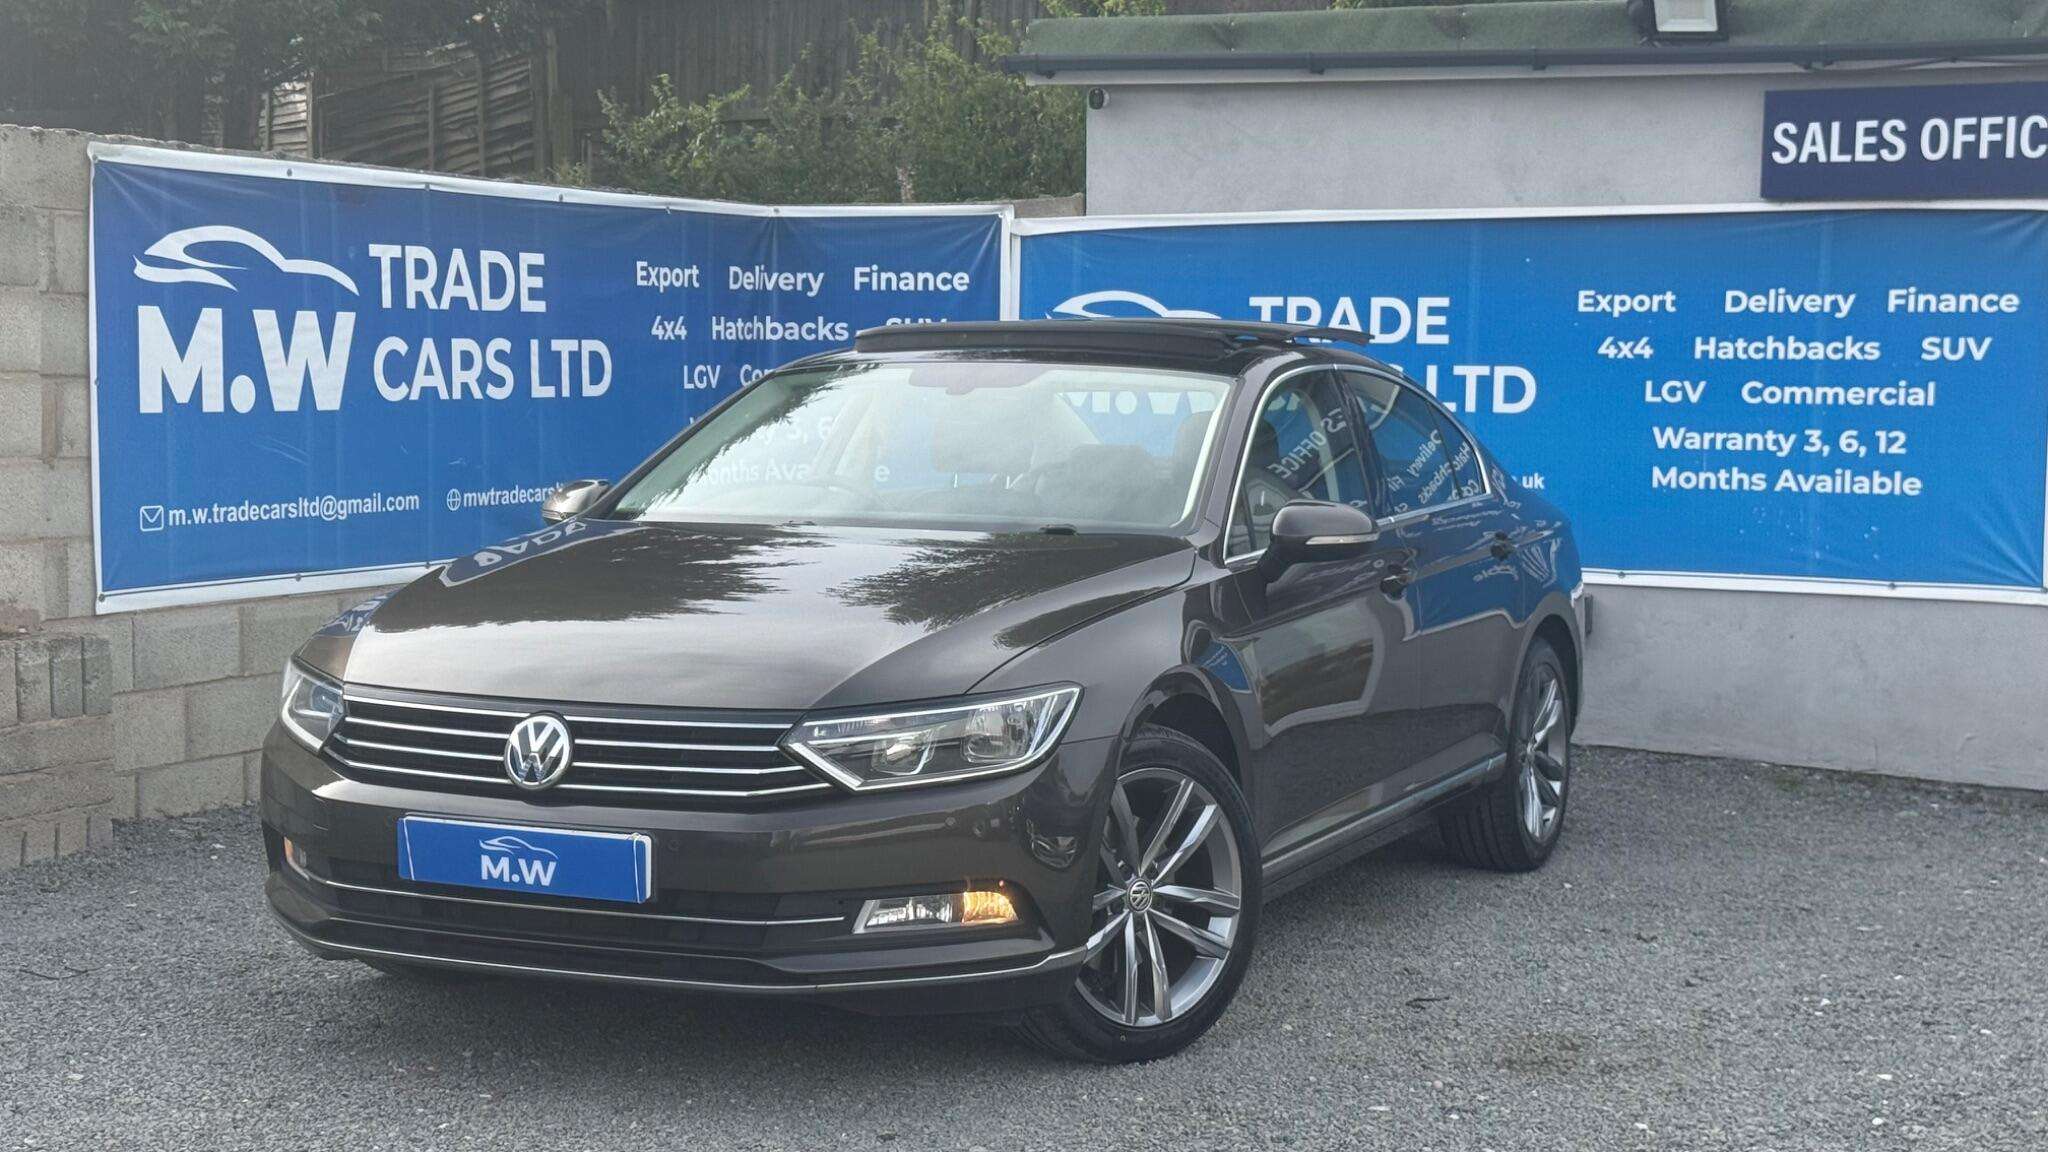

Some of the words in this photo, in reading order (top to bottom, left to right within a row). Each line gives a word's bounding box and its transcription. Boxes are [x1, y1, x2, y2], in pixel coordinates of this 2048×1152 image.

[1771, 119, 1906, 164] SALES
[368, 243, 546, 313] TRADE
[636, 260, 700, 292] Export
[728, 264, 825, 298] Delivery
[853, 264, 971, 292] Finance
[1577, 290, 1676, 318] Export
[1725, 287, 1856, 318] Delivery
[1888, 286, 2020, 313] Finance
[651, 314, 688, 341] 4x4
[711, 315, 850, 342] Hatchbacks
[137, 305, 357, 414] M.W
[1598, 336, 1654, 360] 4x4
[1694, 335, 1881, 361] Hatchbacks
[1921, 336, 1993, 361] SUV
[373, 336, 515, 402] CARS
[530, 338, 613, 398] LTD
[683, 364, 722, 389] LGV
[1644, 380, 1706, 403] LGV
[1741, 380, 1936, 406] Commercial
[1653, 426, 1796, 457] Warranty
[1803, 430, 1830, 457] 3,
[1839, 430, 1867, 457] 6,
[1876, 430, 1906, 454] 12
[1652, 466, 1767, 491] Months
[1774, 468, 1922, 496] Available
[168, 492, 420, 527] m.w.tradecarsltd@gmail.com
[480, 853, 557, 887] M.W
